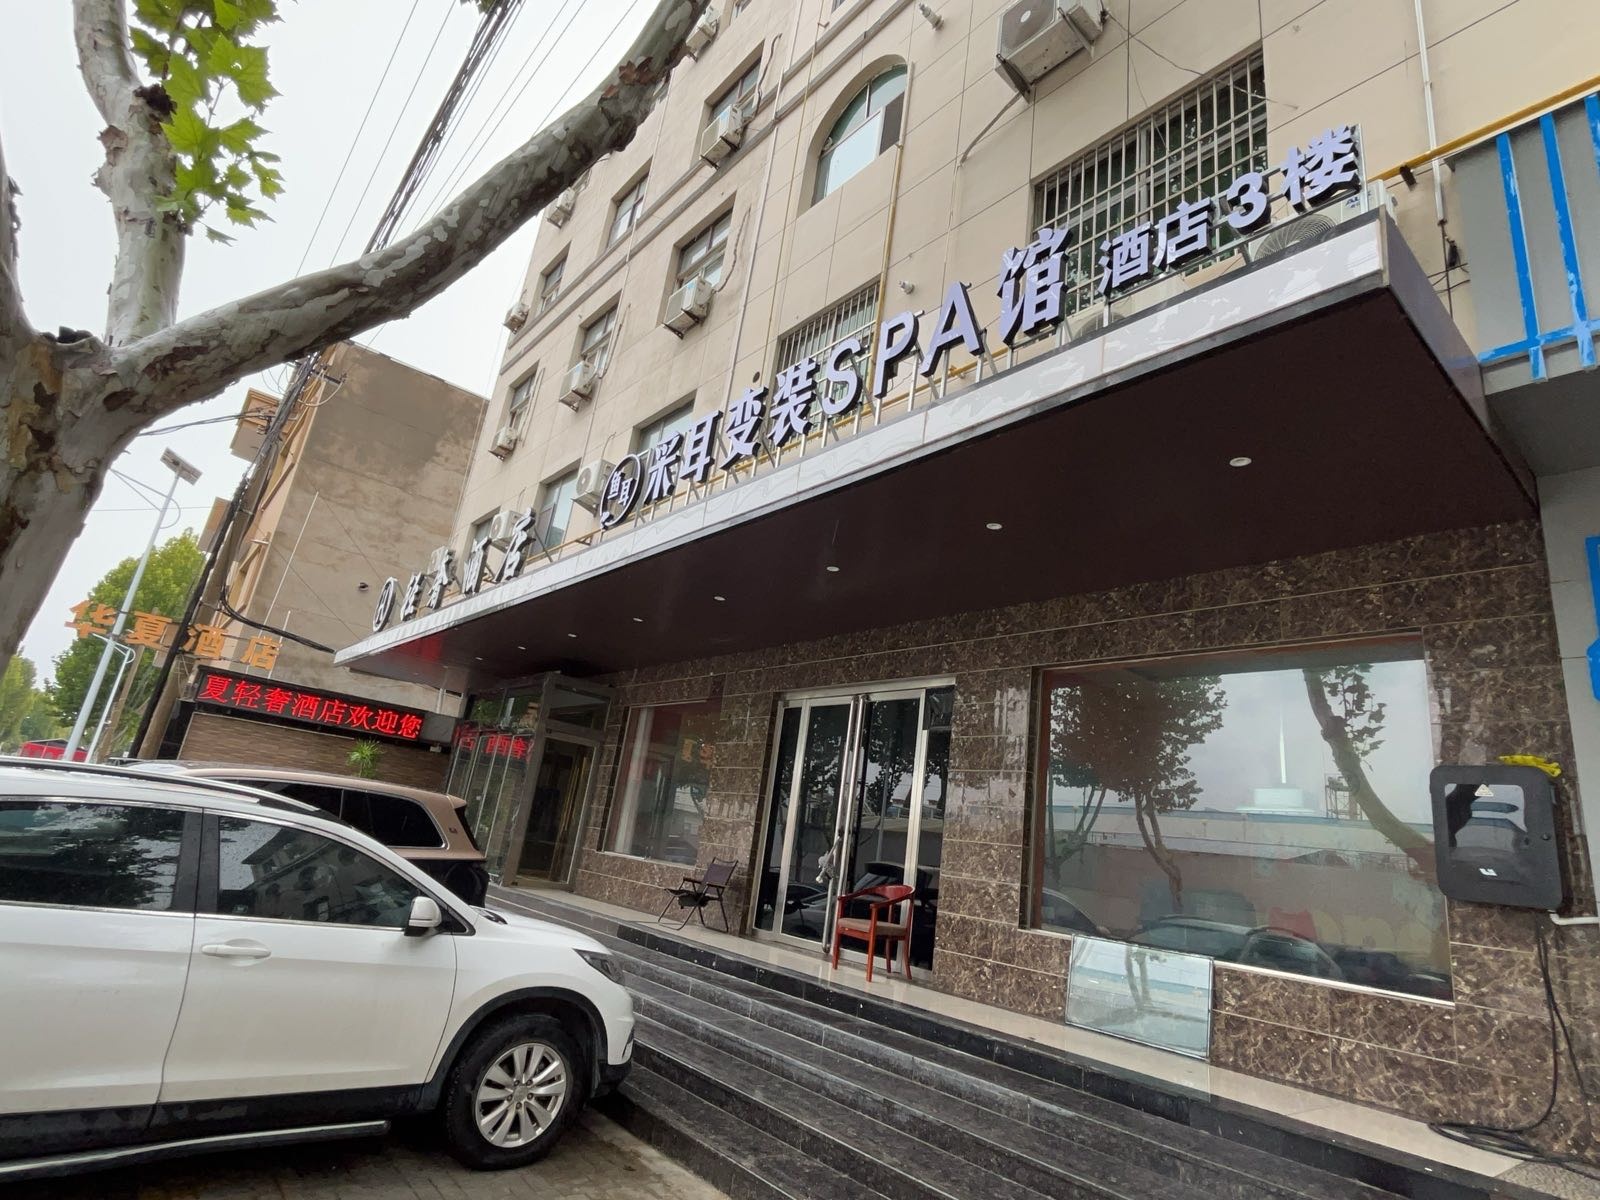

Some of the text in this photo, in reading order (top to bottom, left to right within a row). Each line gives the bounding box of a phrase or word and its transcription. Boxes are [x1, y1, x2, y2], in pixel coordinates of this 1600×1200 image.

[65, 600, 283, 670] 华夏酒店
[200, 673, 422, 740] 夏轻奢酒店欢迎您
